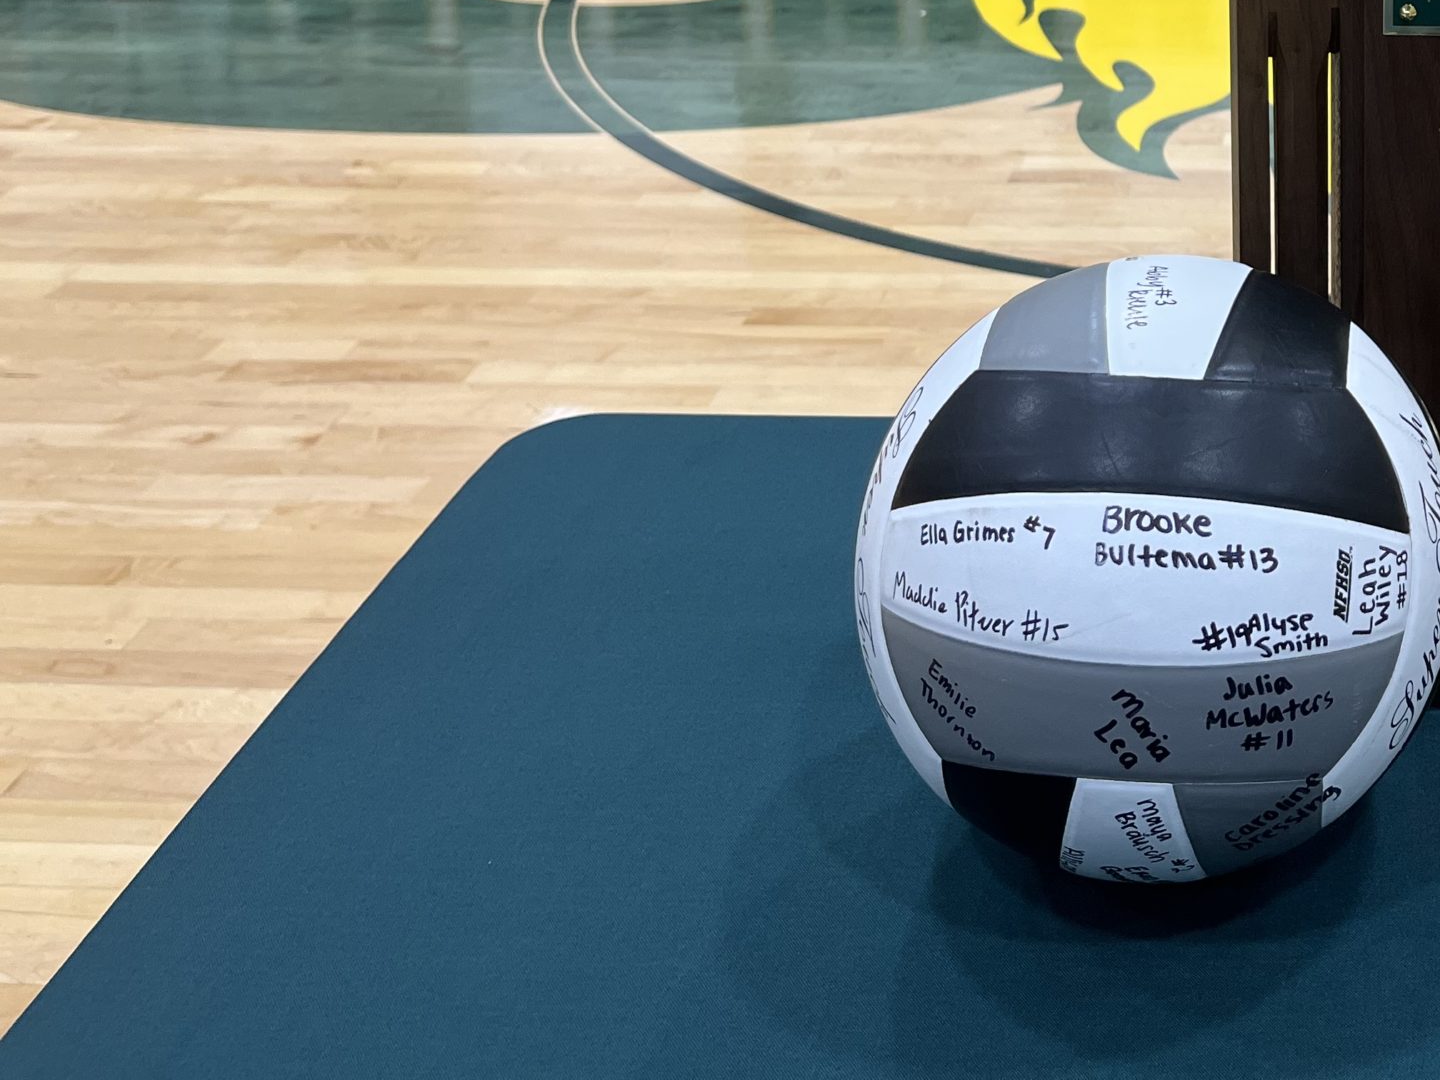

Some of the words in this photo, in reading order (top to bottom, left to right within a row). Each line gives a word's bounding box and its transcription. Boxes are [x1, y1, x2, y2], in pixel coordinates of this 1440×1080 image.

[920, 522, 948, 546] Ella
[953, 520, 1016, 544] Grimes
[1102, 505, 1213, 538] Brooke
[893, 570, 948, 615] Maddie
[1021, 608, 1070, 643] #15
[1352, 557, 1378, 636] Leah
[1374, 544, 1399, 627] Wiley
[1254, 632, 1329, 659] Smith
[928, 658, 977, 719] Emilie
[1222, 673, 1294, 702] Julia
[920, 677, 996, 762] Thornton
